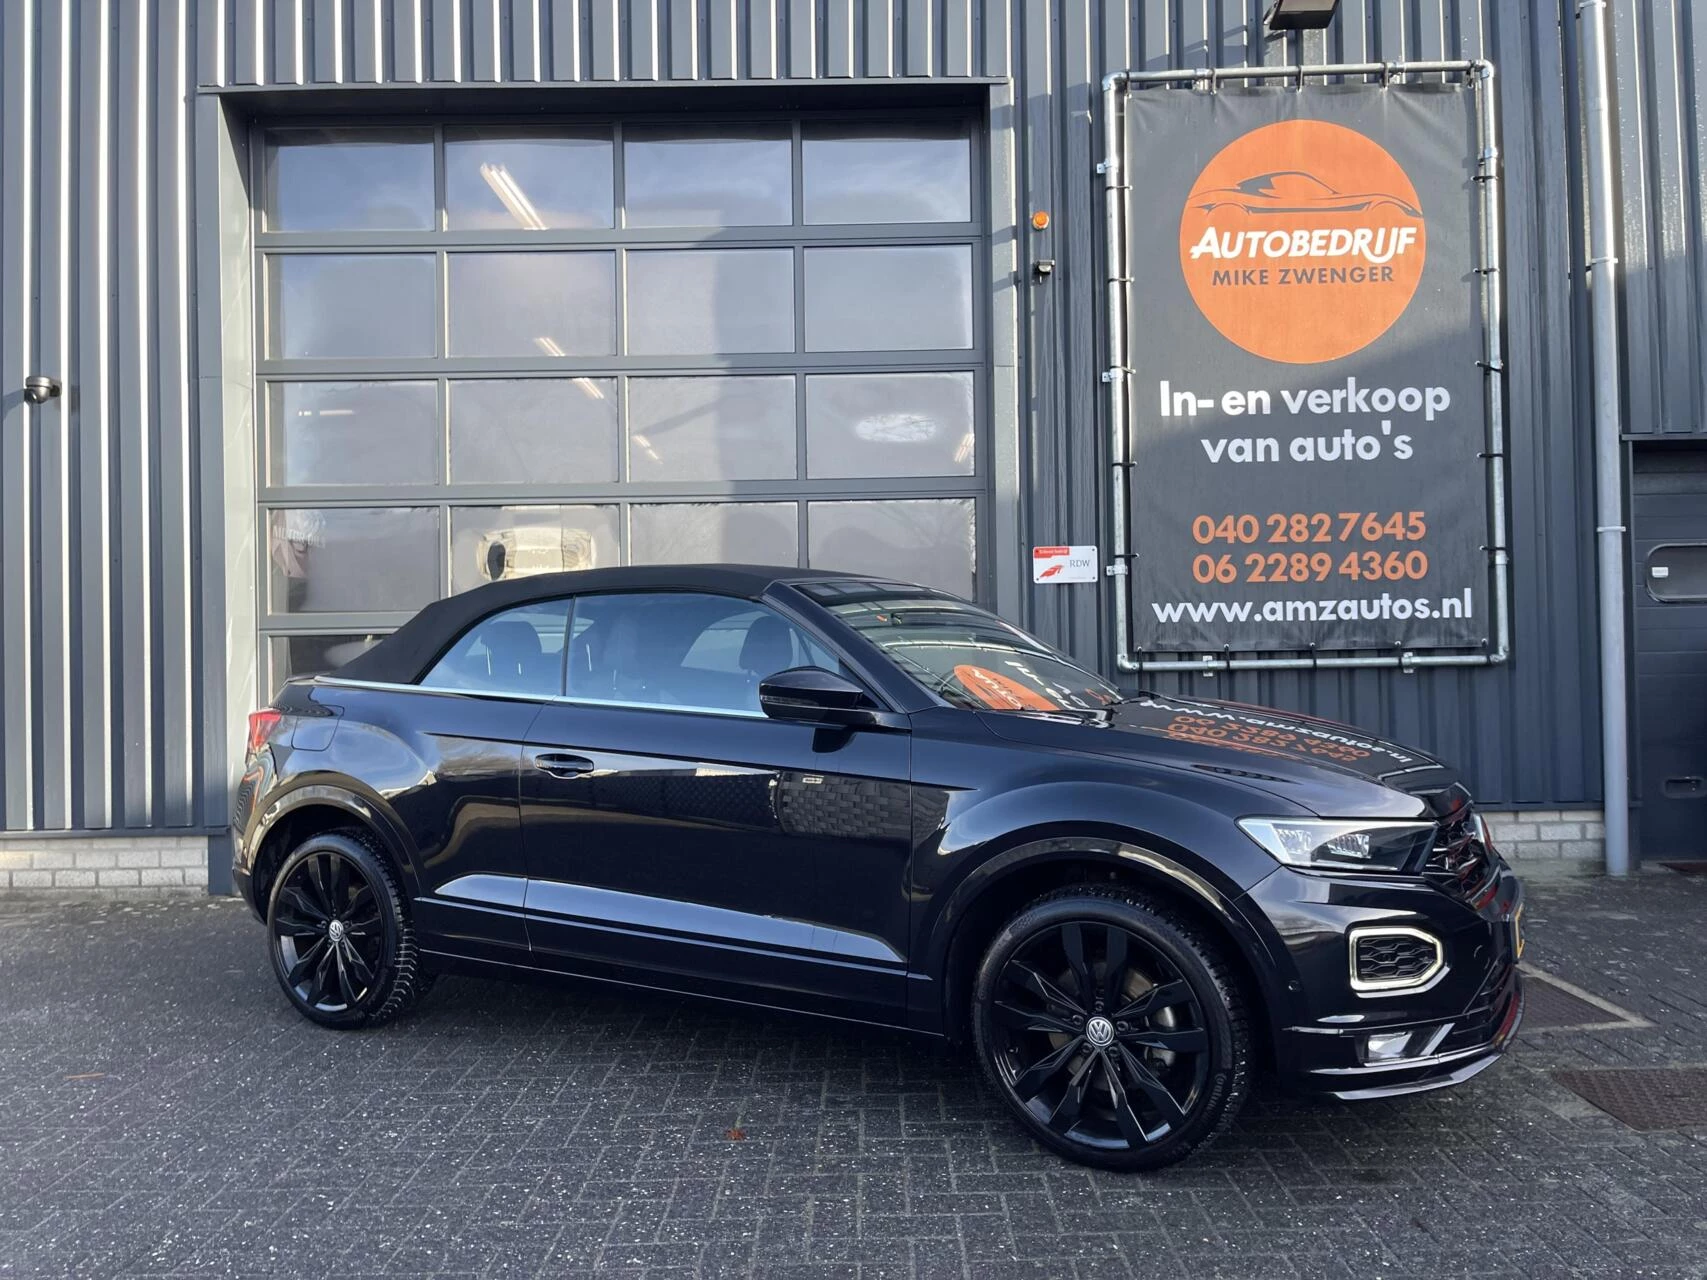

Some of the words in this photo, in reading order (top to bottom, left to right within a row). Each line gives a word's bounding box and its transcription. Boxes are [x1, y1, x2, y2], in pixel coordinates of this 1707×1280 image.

[1189, 226, 1417, 263] AUTOBEDRIJF
[1212, 269, 1268, 286] MIKE
[1278, 266, 1394, 285] ZWENGER
[1160, 380, 1214, 416] In-
[1221, 389, 1271, 415] en
[1280, 377, 1451, 421] verkoop
[1200, 436, 1280, 463] van
[1289, 420, 1414, 462] auto's
[1192, 515, 1259, 544] 040
[1266, 512, 1332, 543] 282
[1338, 511, 1427, 542] 7645
[1069, 559, 1091, 568] RDW
[1192, 554, 1237, 584] 06
[1245, 552, 1332, 583] 2289
[1339, 550, 1428, 581] 4360
[1151, 587, 1472, 623] www.amzautos.nl
